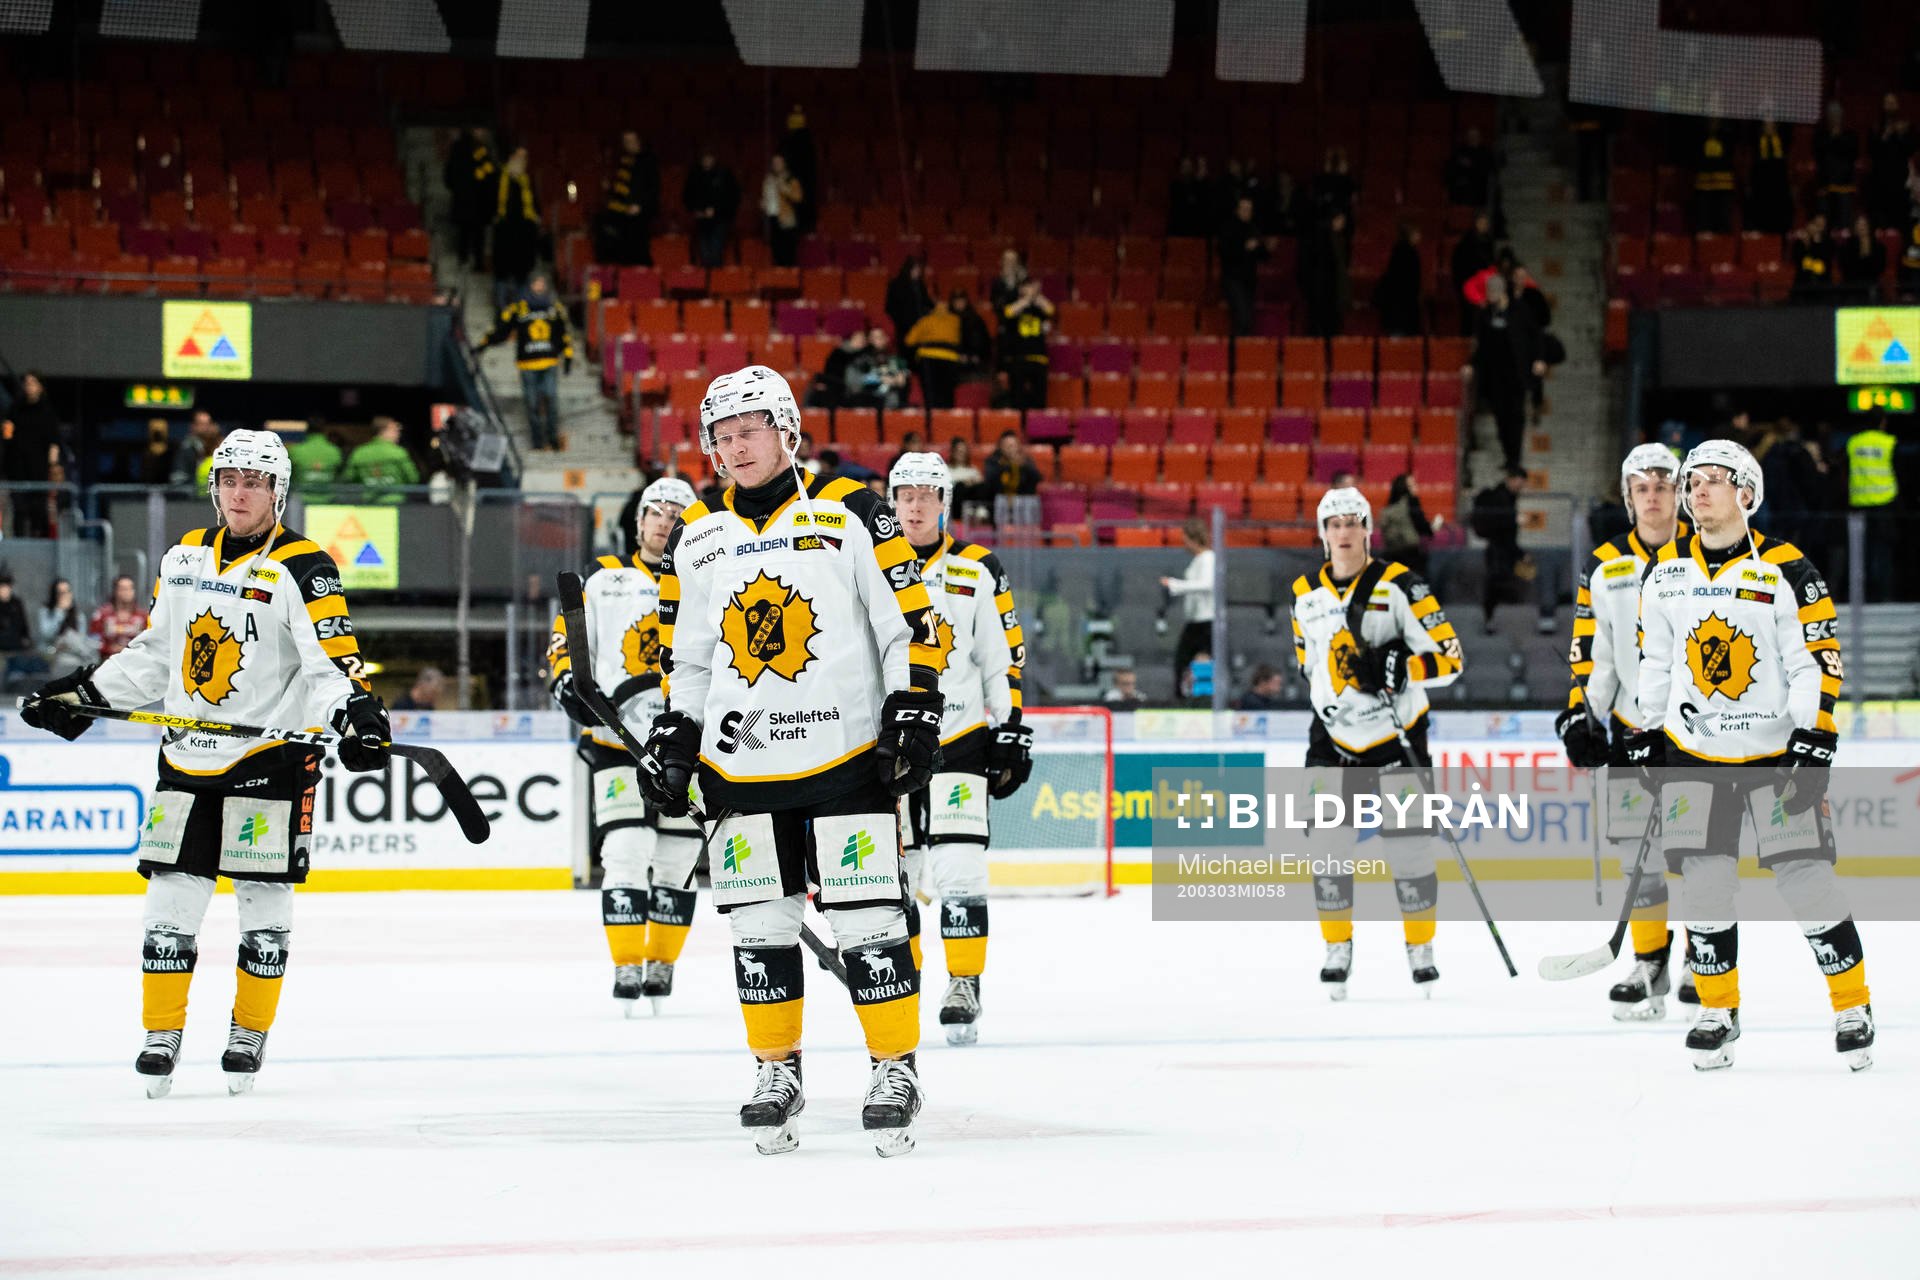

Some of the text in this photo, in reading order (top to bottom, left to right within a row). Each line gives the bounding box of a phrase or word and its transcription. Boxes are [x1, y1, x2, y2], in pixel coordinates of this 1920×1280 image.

[736, 537, 788, 556] BOLIDEN
[201, 580, 237, 595] BOLIDEN
[1692, 587, 1732, 597] BOLIDEN
[245, 613, 259, 641] A
[769, 707, 840, 725] Skellefteå
[770, 727, 807, 741] Kraft
[1721, 722, 1750, 731] Kraft
[191, 737, 217, 750] Kraft
[1031, 778, 1227, 821] Assemblin
[1439, 800, 1590, 843] SPORT
[224, 849, 285, 863] martinsons
[714, 874, 777, 890] martinsons
[824, 874, 894, 887] martinsons
[143, 958, 188, 970] NORRAN
[246, 960, 285, 976] NORRAN
[857, 979, 912, 1001] NORRAN
